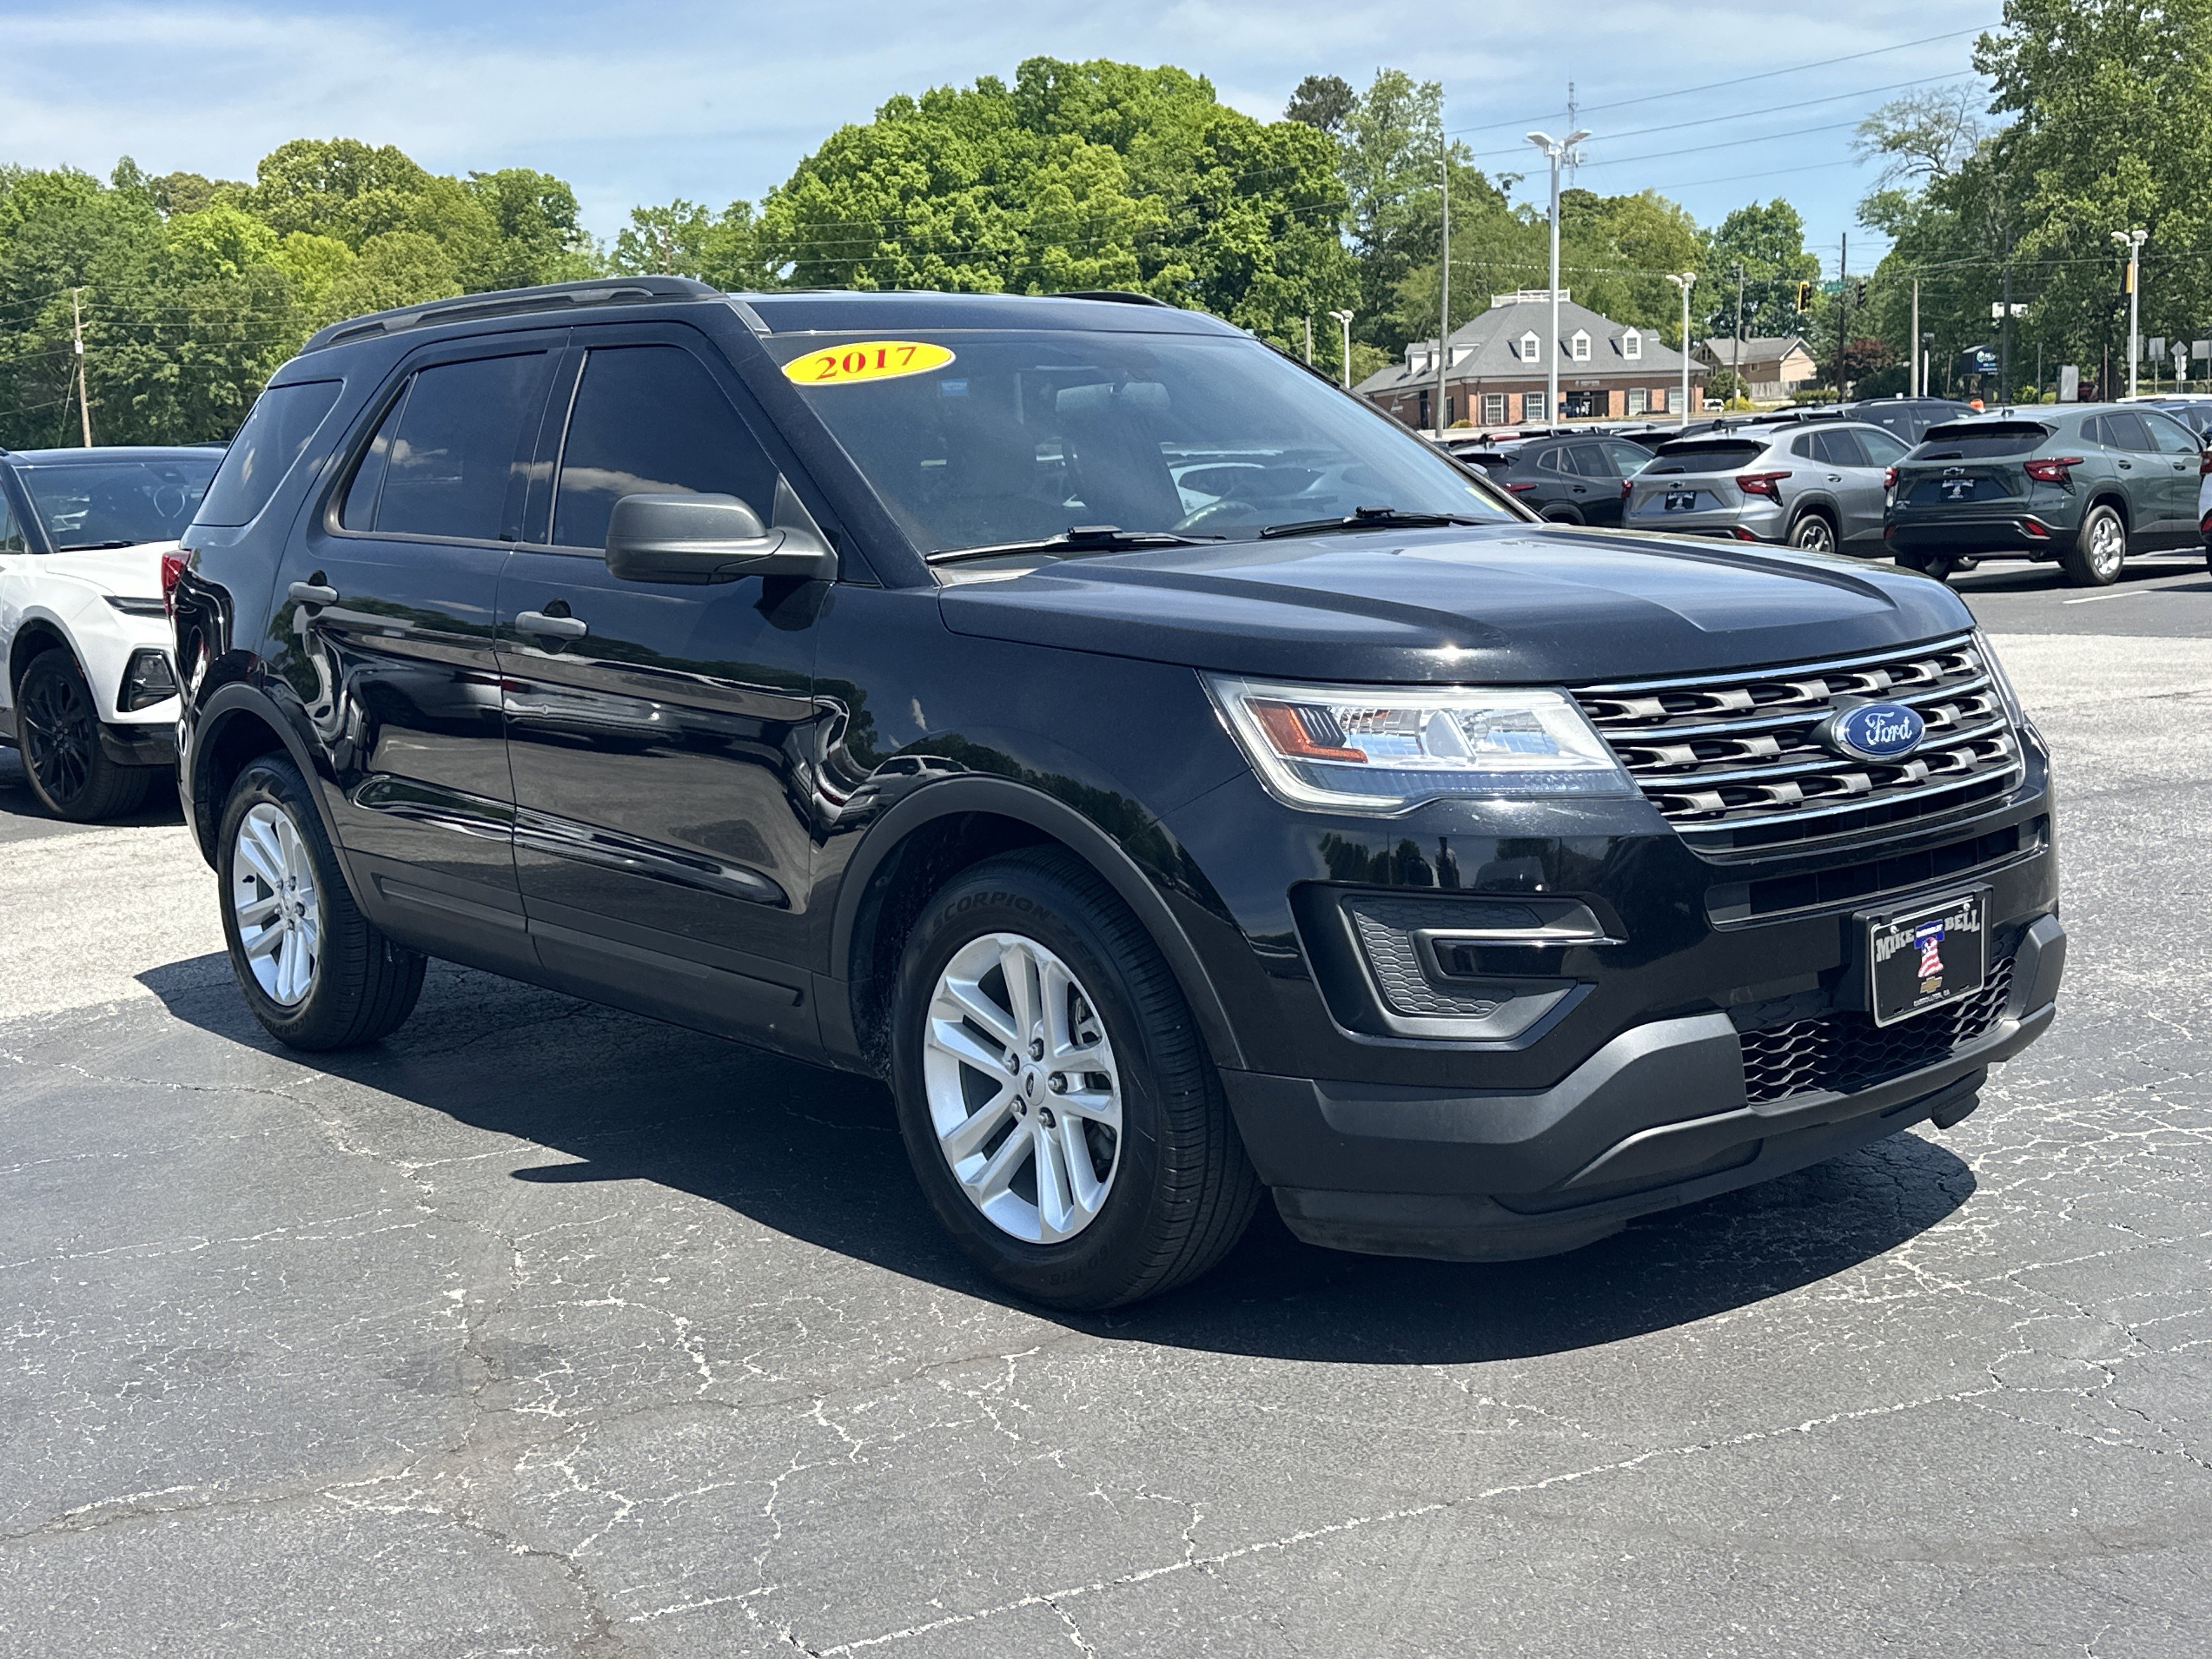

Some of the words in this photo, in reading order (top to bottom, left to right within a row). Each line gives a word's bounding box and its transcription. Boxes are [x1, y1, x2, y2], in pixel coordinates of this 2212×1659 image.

[815, 346, 917, 380] 2017
[1865, 712, 1913, 746] Ford
[932, 891, 1052, 935] SCORPION
[1876, 928, 1915, 962] MIKE
[1944, 909, 1980, 933] BELL
